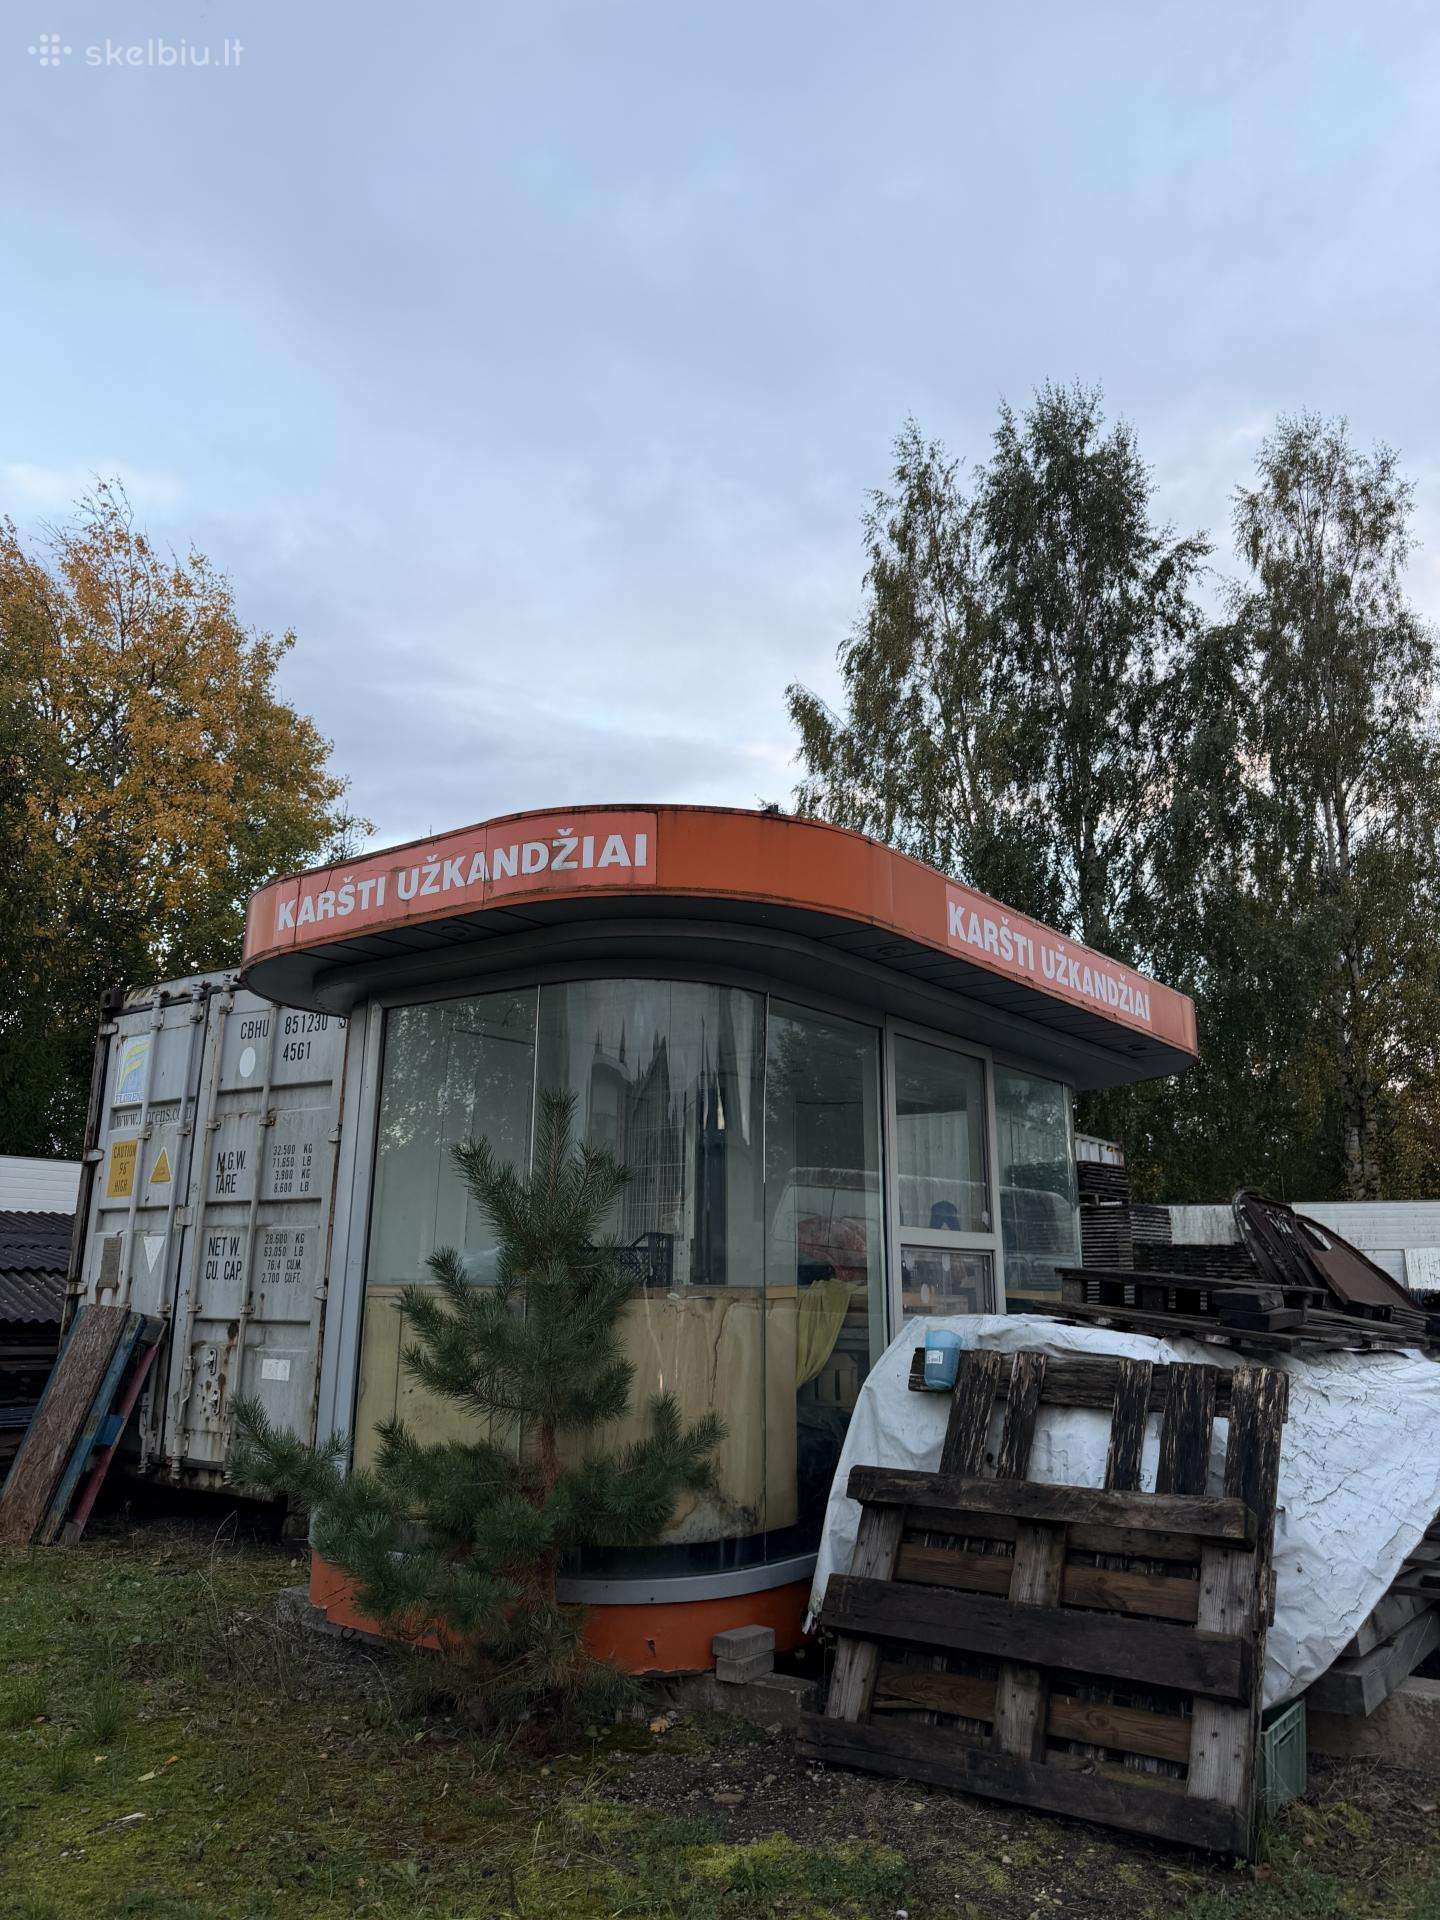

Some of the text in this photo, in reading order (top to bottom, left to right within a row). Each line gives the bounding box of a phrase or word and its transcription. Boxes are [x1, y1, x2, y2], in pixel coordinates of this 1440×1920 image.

[277, 828, 648, 931] KARŠTI UŽKANDŽIAI
[948, 901, 1151, 1022] KARŠTI UŽKANDŽIAI
[240, 1019, 270, 1040] CBHU
[284, 1013, 329, 1035] 851230
[283, 1041, 312, 1062] 45G1
[216, 1150, 247, 1172] M.G.W.
[303, 1143, 313, 1154] KG
[302, 1155, 312, 1167] LB
[215, 1173, 238, 1194] TARE
[301, 1168, 311, 1180] KG
[299, 1181, 310, 1193] LB
[207, 1237, 227, 1257] NET
[229, 1237, 241, 1257] W.
[294, 1232, 306, 1244] KG
[293, 1245, 305, 1257] LB
[205, 1261, 219, 1281] CU.
[223, 1260, 243, 1281] CAP.
[261, 1272, 280, 1284] 2.700
